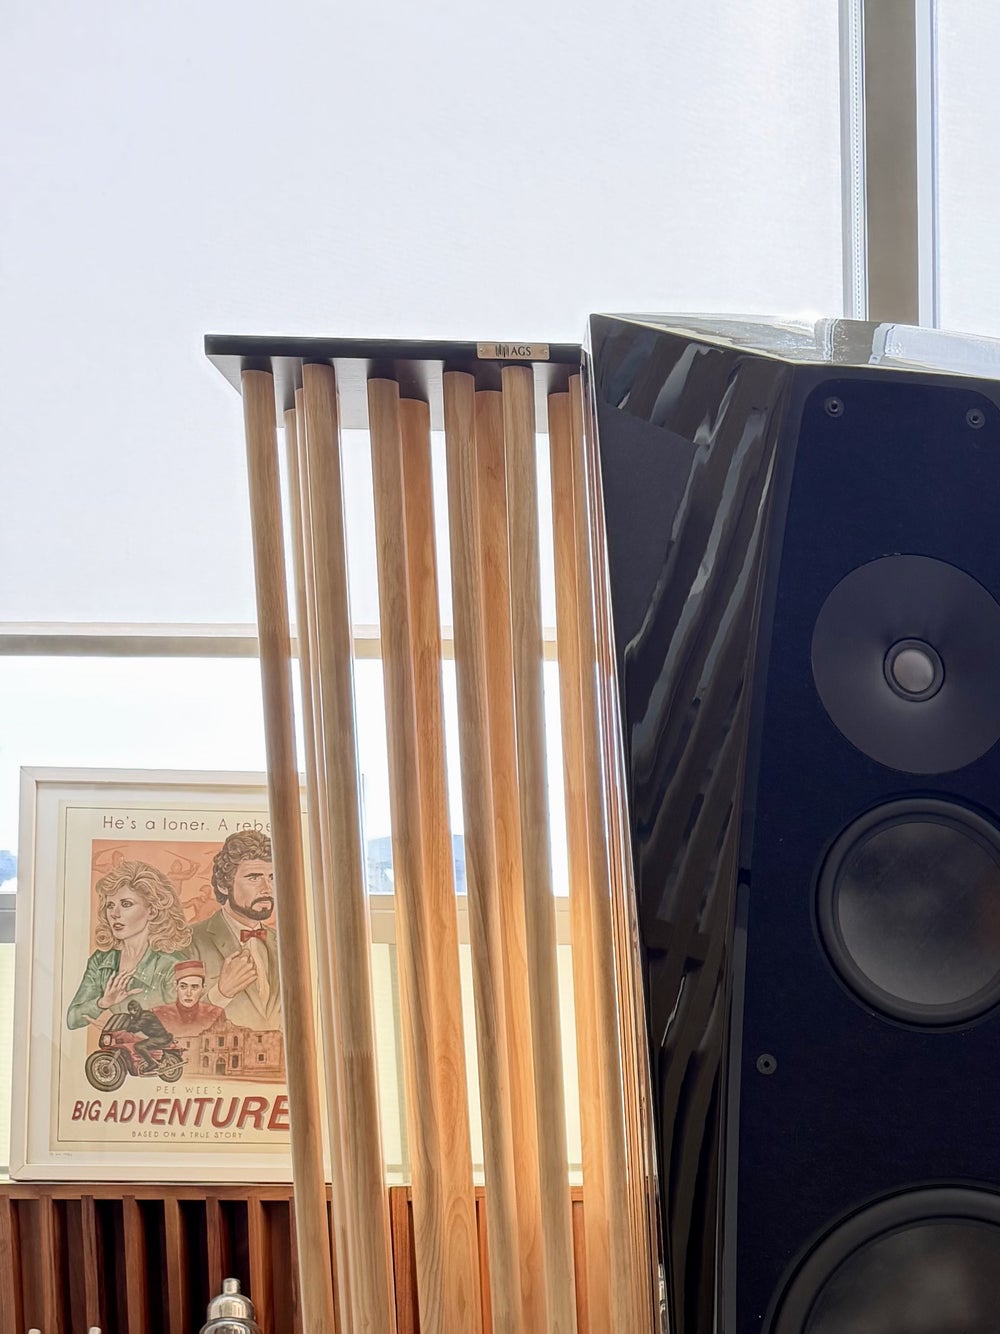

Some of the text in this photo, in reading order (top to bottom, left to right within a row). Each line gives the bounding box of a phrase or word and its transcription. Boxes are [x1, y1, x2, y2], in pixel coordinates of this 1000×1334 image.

[511, 346, 532, 357] AGS
[103, 816, 137, 830] He's
[145, 819, 155, 830] a
[163, 817, 209, 831] loner.
[218, 818, 228, 831] A
[156, 1086, 176, 1095] PEE
[71, 1095, 290, 1132] BIG ADVENTURE
